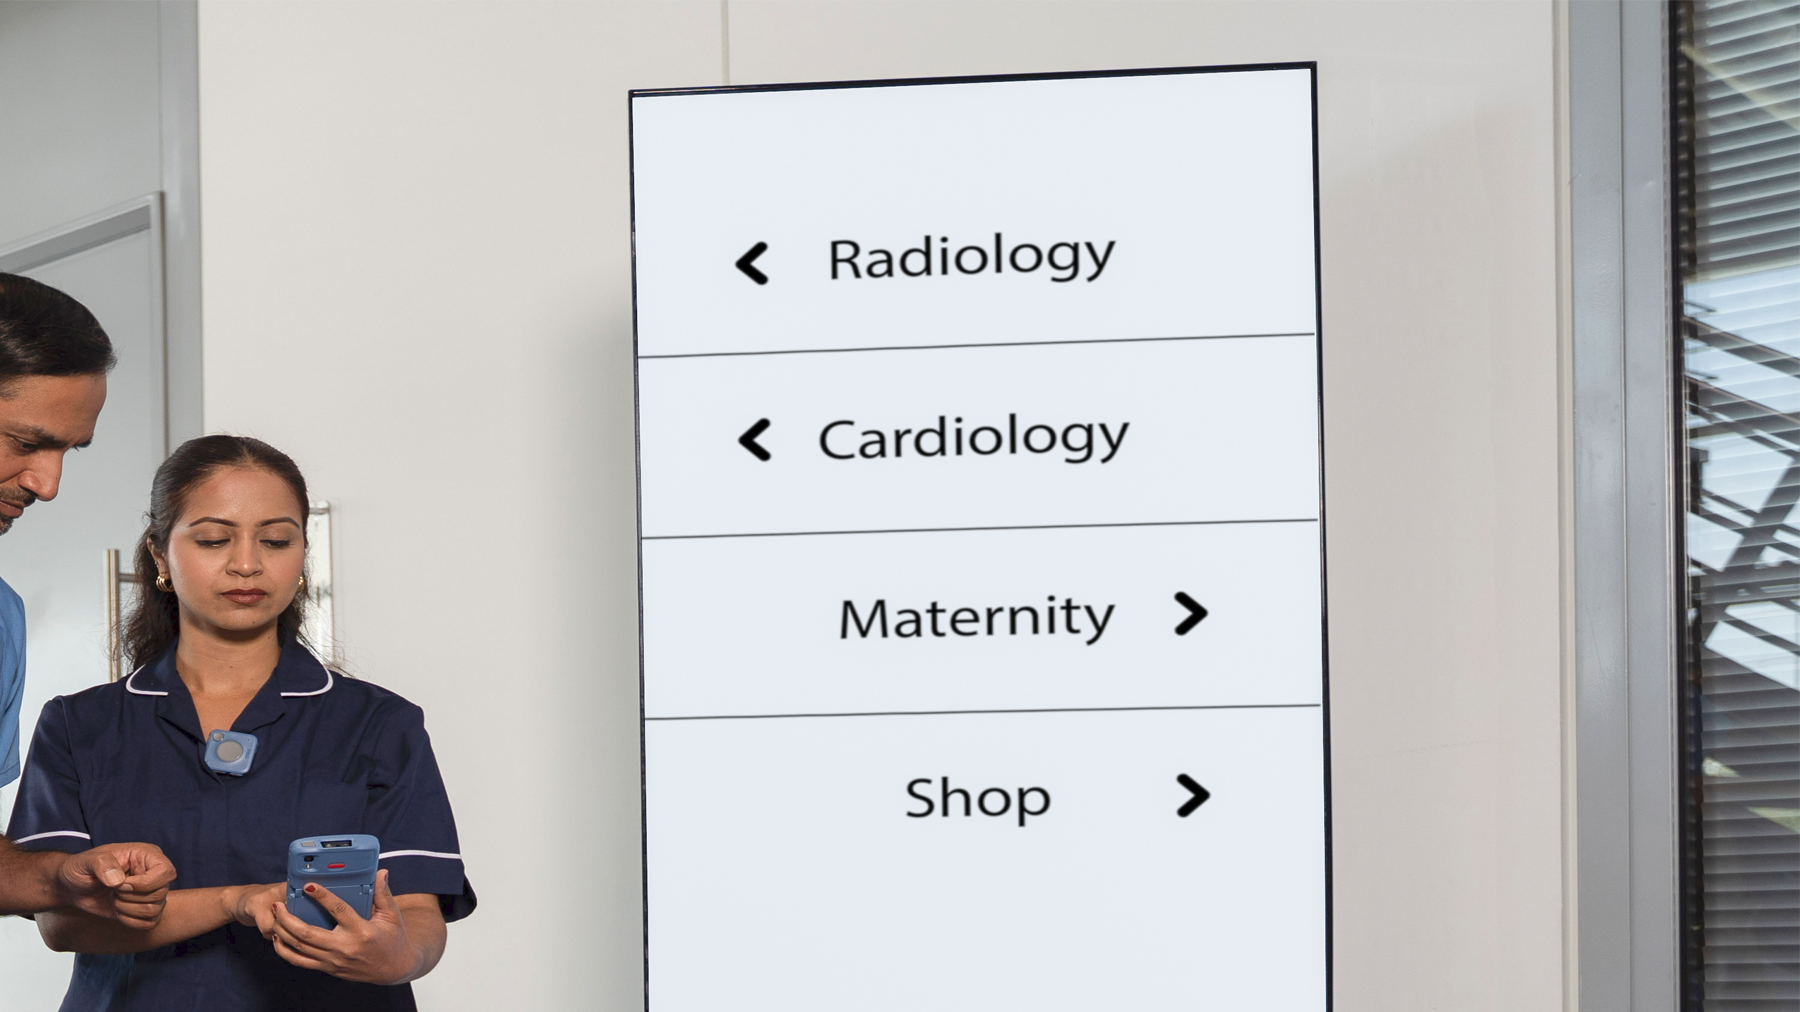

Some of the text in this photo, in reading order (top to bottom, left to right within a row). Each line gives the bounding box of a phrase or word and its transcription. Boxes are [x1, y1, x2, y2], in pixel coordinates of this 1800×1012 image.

[829, 232, 1117, 284] Radiology
[818, 413, 1131, 465] Cardiology
[839, 595, 1117, 647] Maternity
[905, 776, 1052, 828] Shop
